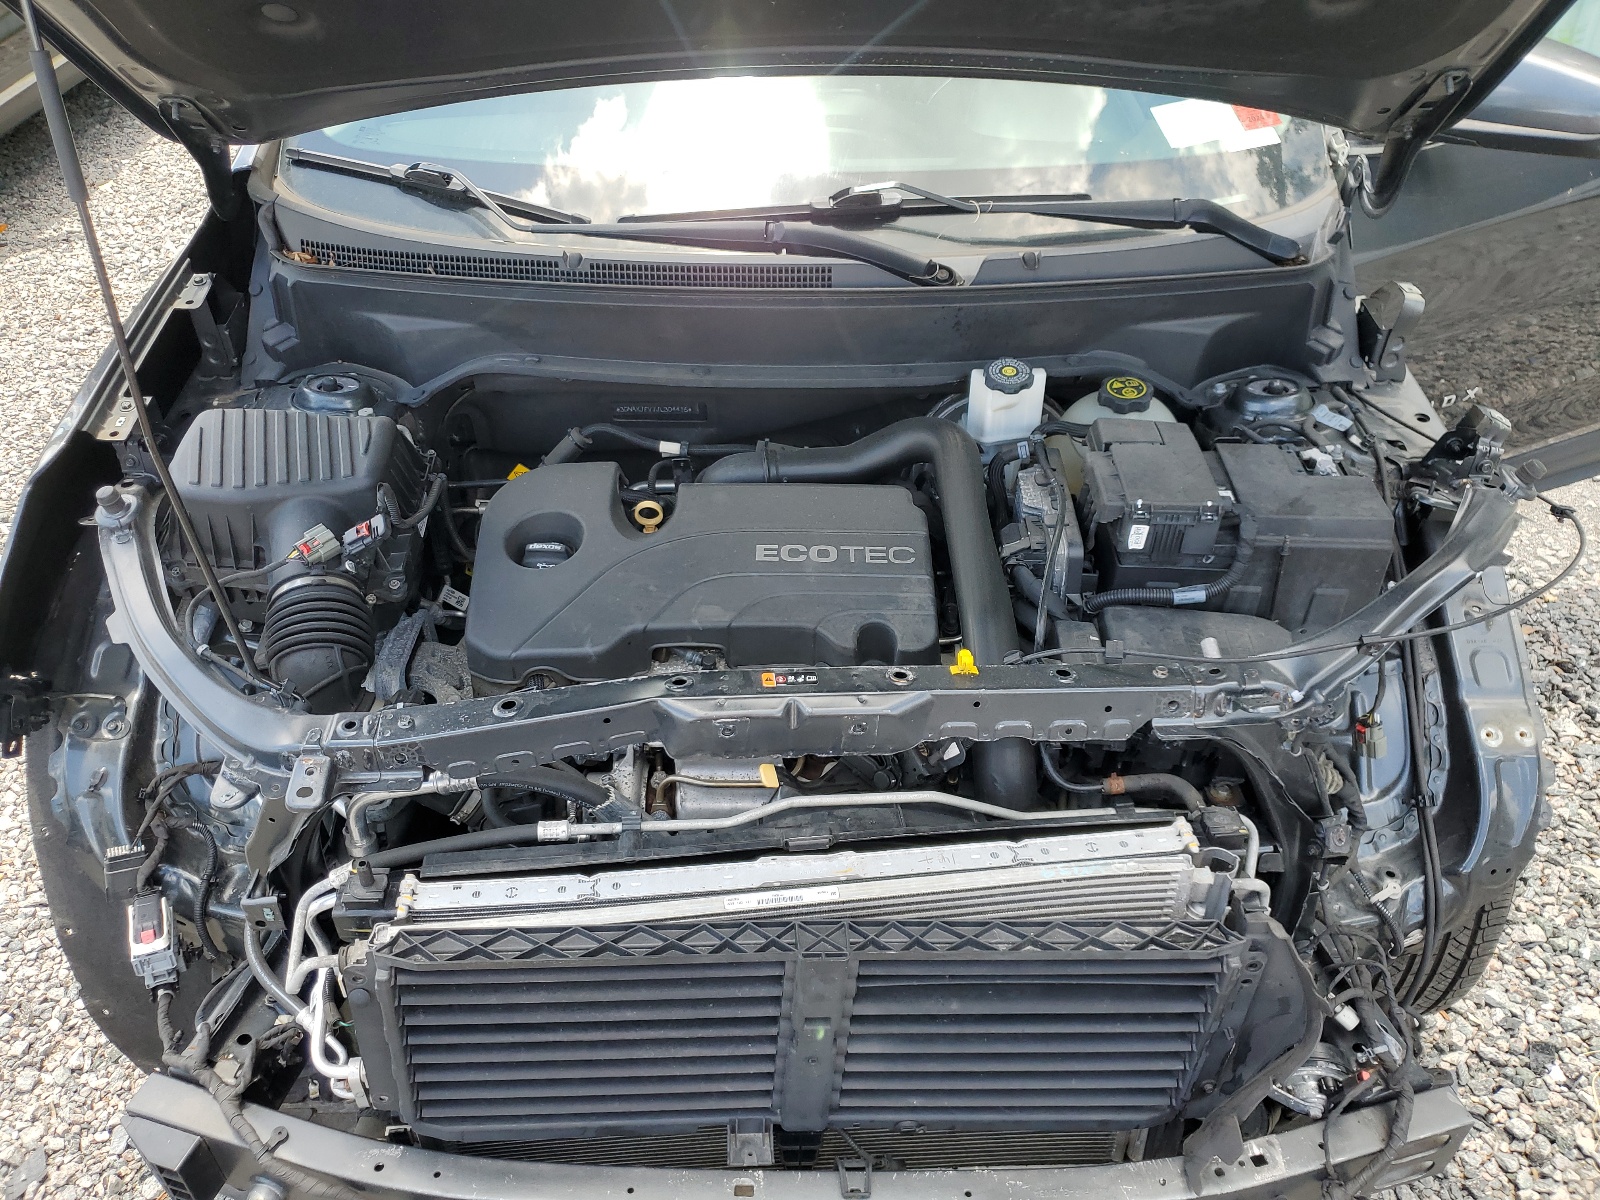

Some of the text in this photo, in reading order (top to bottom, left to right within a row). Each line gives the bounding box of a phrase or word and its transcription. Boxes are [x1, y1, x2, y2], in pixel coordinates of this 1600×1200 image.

[1430, 386, 1480, 409] OX
[529, 542, 562, 551] dexos
[755, 544, 916, 564] ECOTEC
